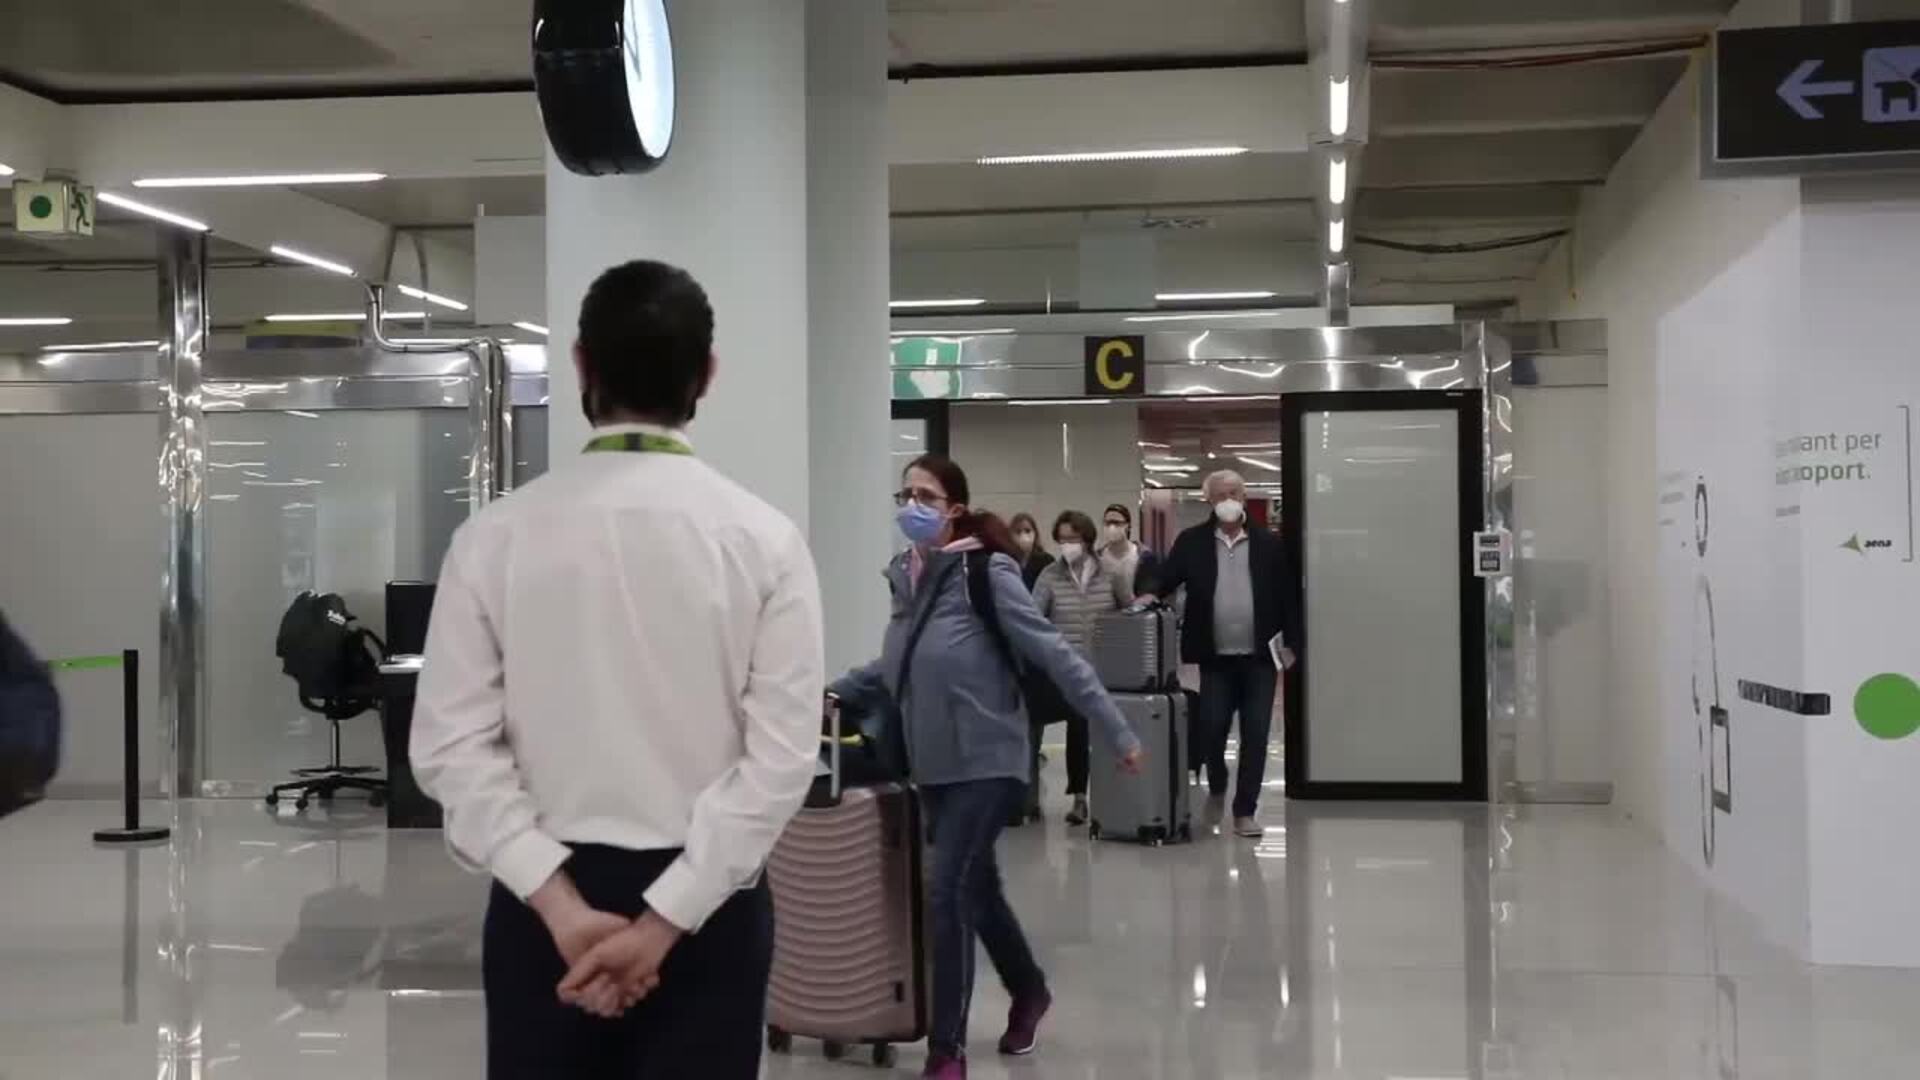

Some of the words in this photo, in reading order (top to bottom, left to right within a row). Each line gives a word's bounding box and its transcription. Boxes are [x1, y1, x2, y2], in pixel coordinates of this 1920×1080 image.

[1096, 340, 1134, 390] C
[1845, 433, 1882, 455] per
[1864, 539, 1892, 548] aena
